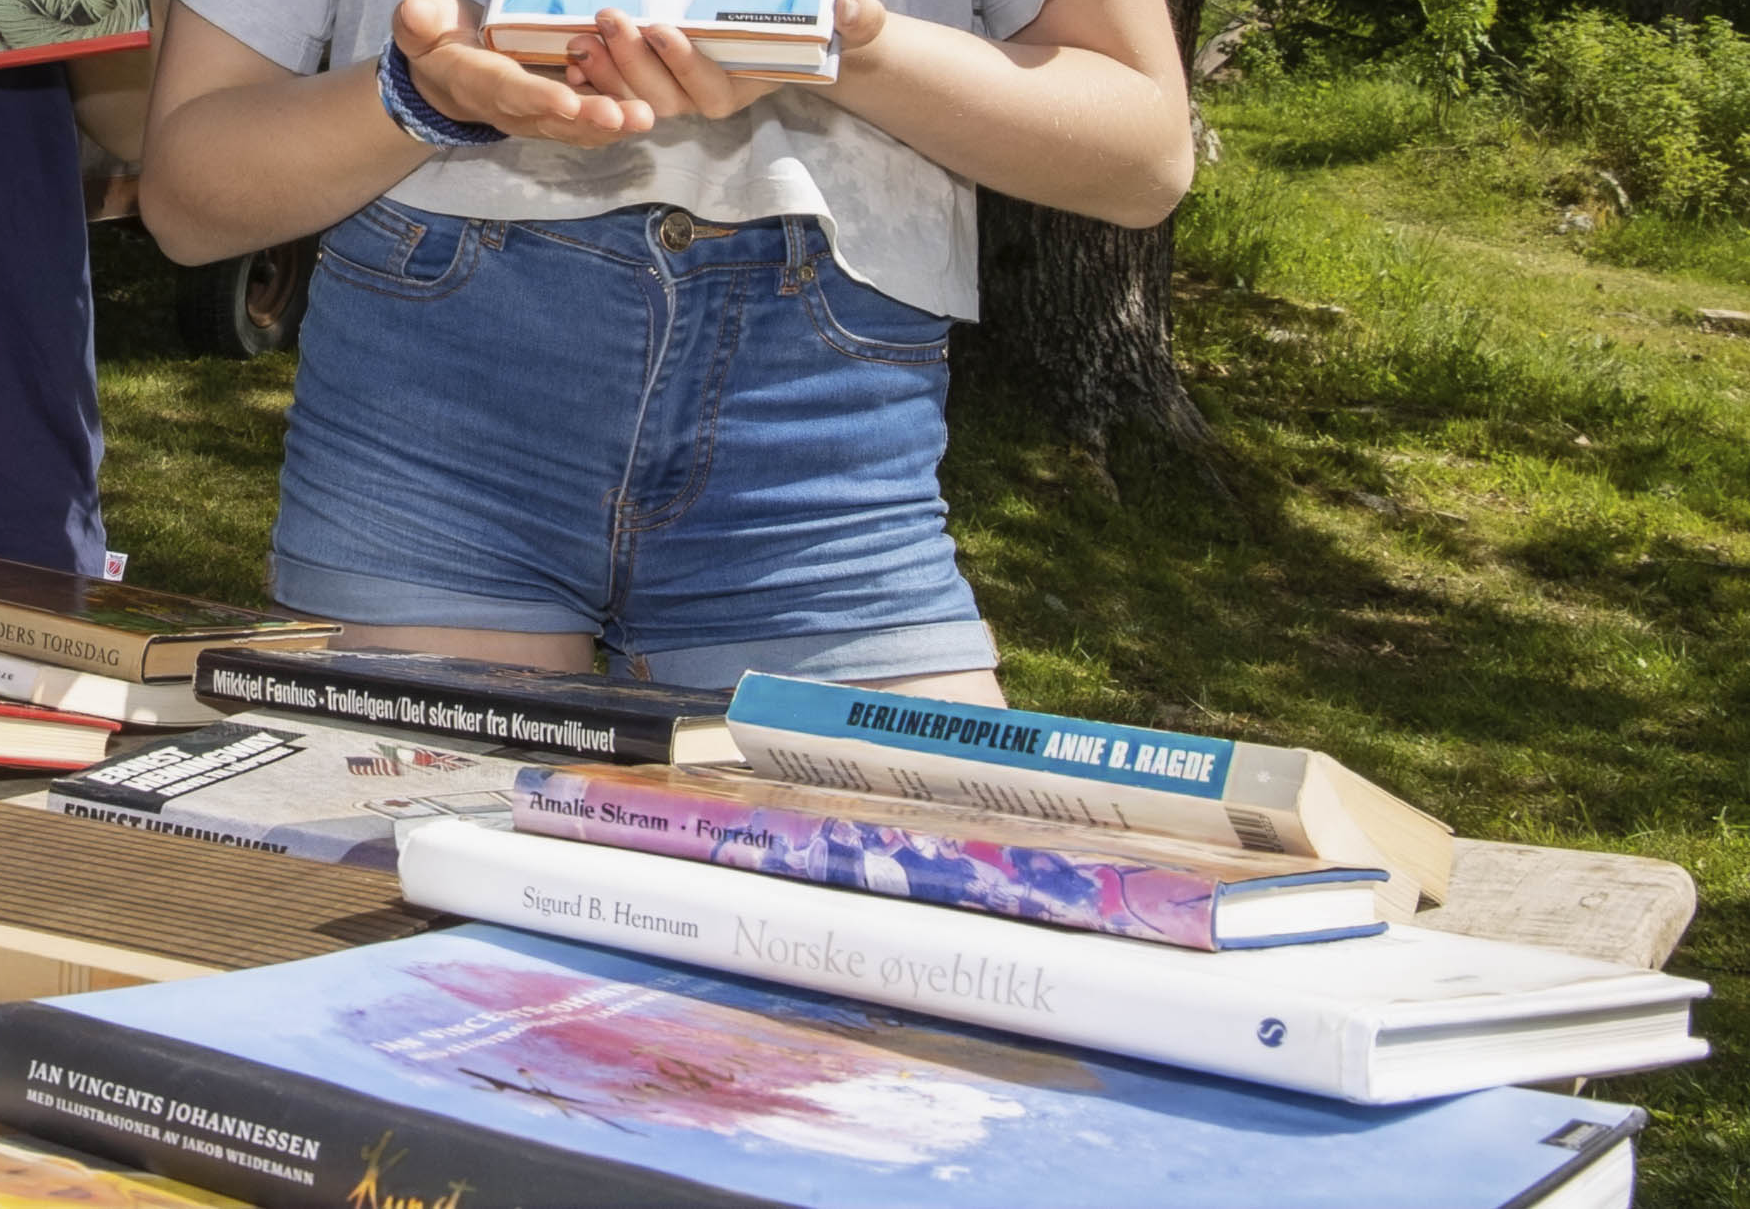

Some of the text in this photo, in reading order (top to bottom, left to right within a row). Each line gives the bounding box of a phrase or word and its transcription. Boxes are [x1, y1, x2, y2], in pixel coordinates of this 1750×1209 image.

[41, 632, 120, 668] TORSDAG
[213, 669, 262, 701] Mikkjel
[266, 679, 316, 708] Fønhus
[429, 701, 482, 732] skriker
[486, 709, 507, 735] fra
[511, 712, 616, 753] Kverrvilljuvet
[847, 701, 1215, 783] BERLINERPOPLENE ANNE B. RAGDE
[87, 746, 194, 785] ERNEST
[121, 732, 284, 792] HEMINGWAY
[530, 791, 776, 849] Amalie Skram Forrådt
[522, 886, 1058, 1015] Sigurd B. Hennum Norske øyeblikk
[26, 1089, 314, 1186] MED ILLUSTRASJONER AV JAKOB WEIDEMANN
[27, 1060, 321, 1161] JAN VINCENTS JOHANNESSEN
